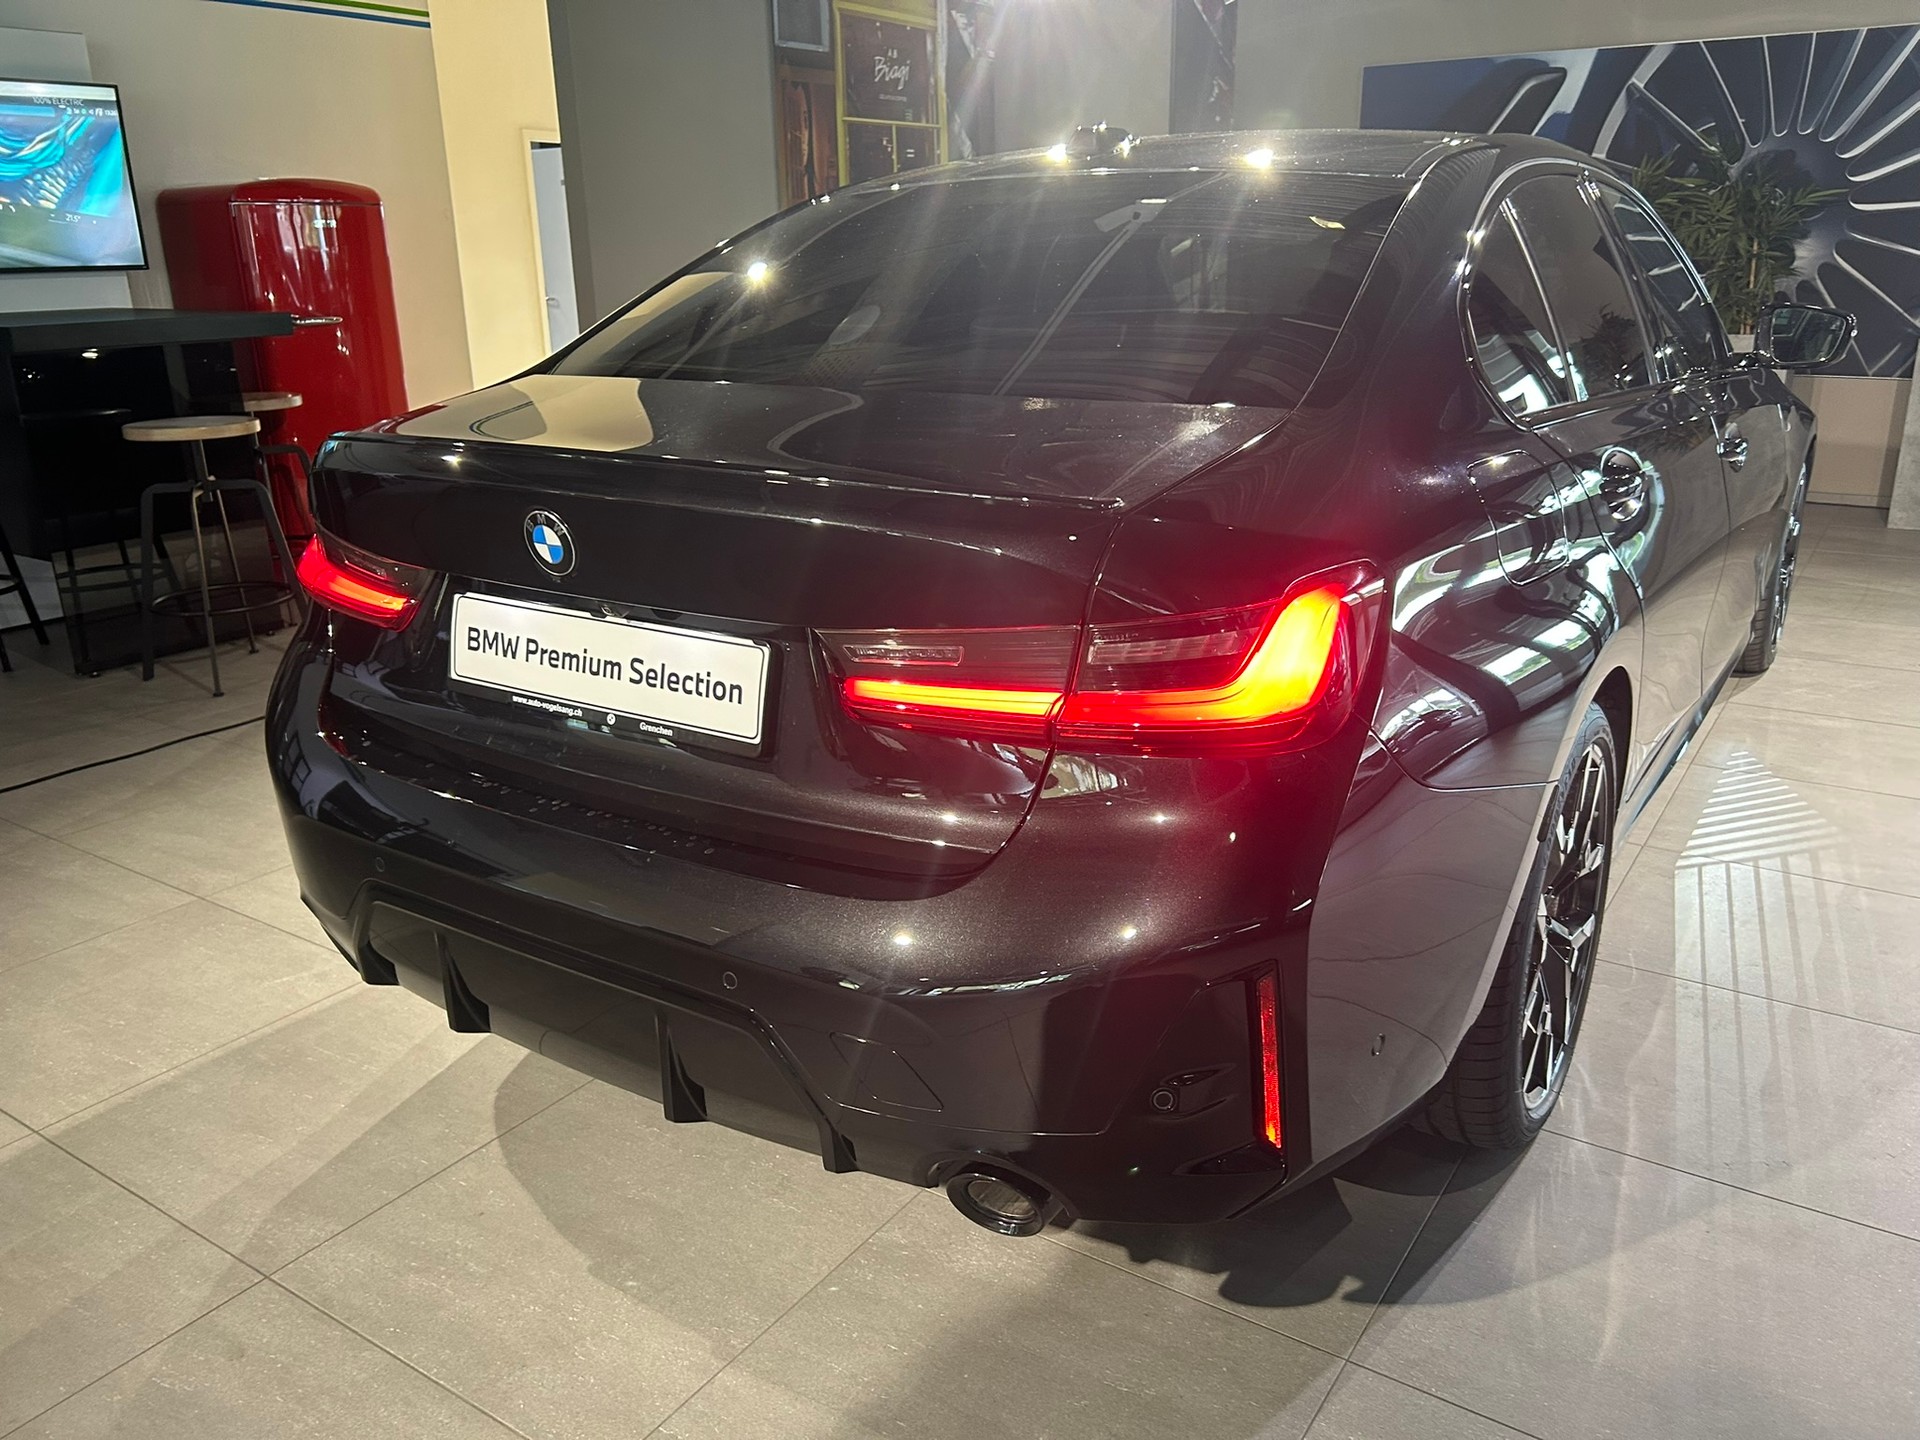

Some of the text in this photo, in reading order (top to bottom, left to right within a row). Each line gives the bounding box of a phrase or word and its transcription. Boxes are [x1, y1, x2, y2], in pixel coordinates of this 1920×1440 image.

[52, 97, 84, 106] ELECTRIC
[526, 513, 566, 536] BMW
[467, 626, 743, 704] BMW Premium Selection
[512, 695, 583, 717] www.auto-vogelsang.ch
[639, 721, 673, 737] Grenchen
